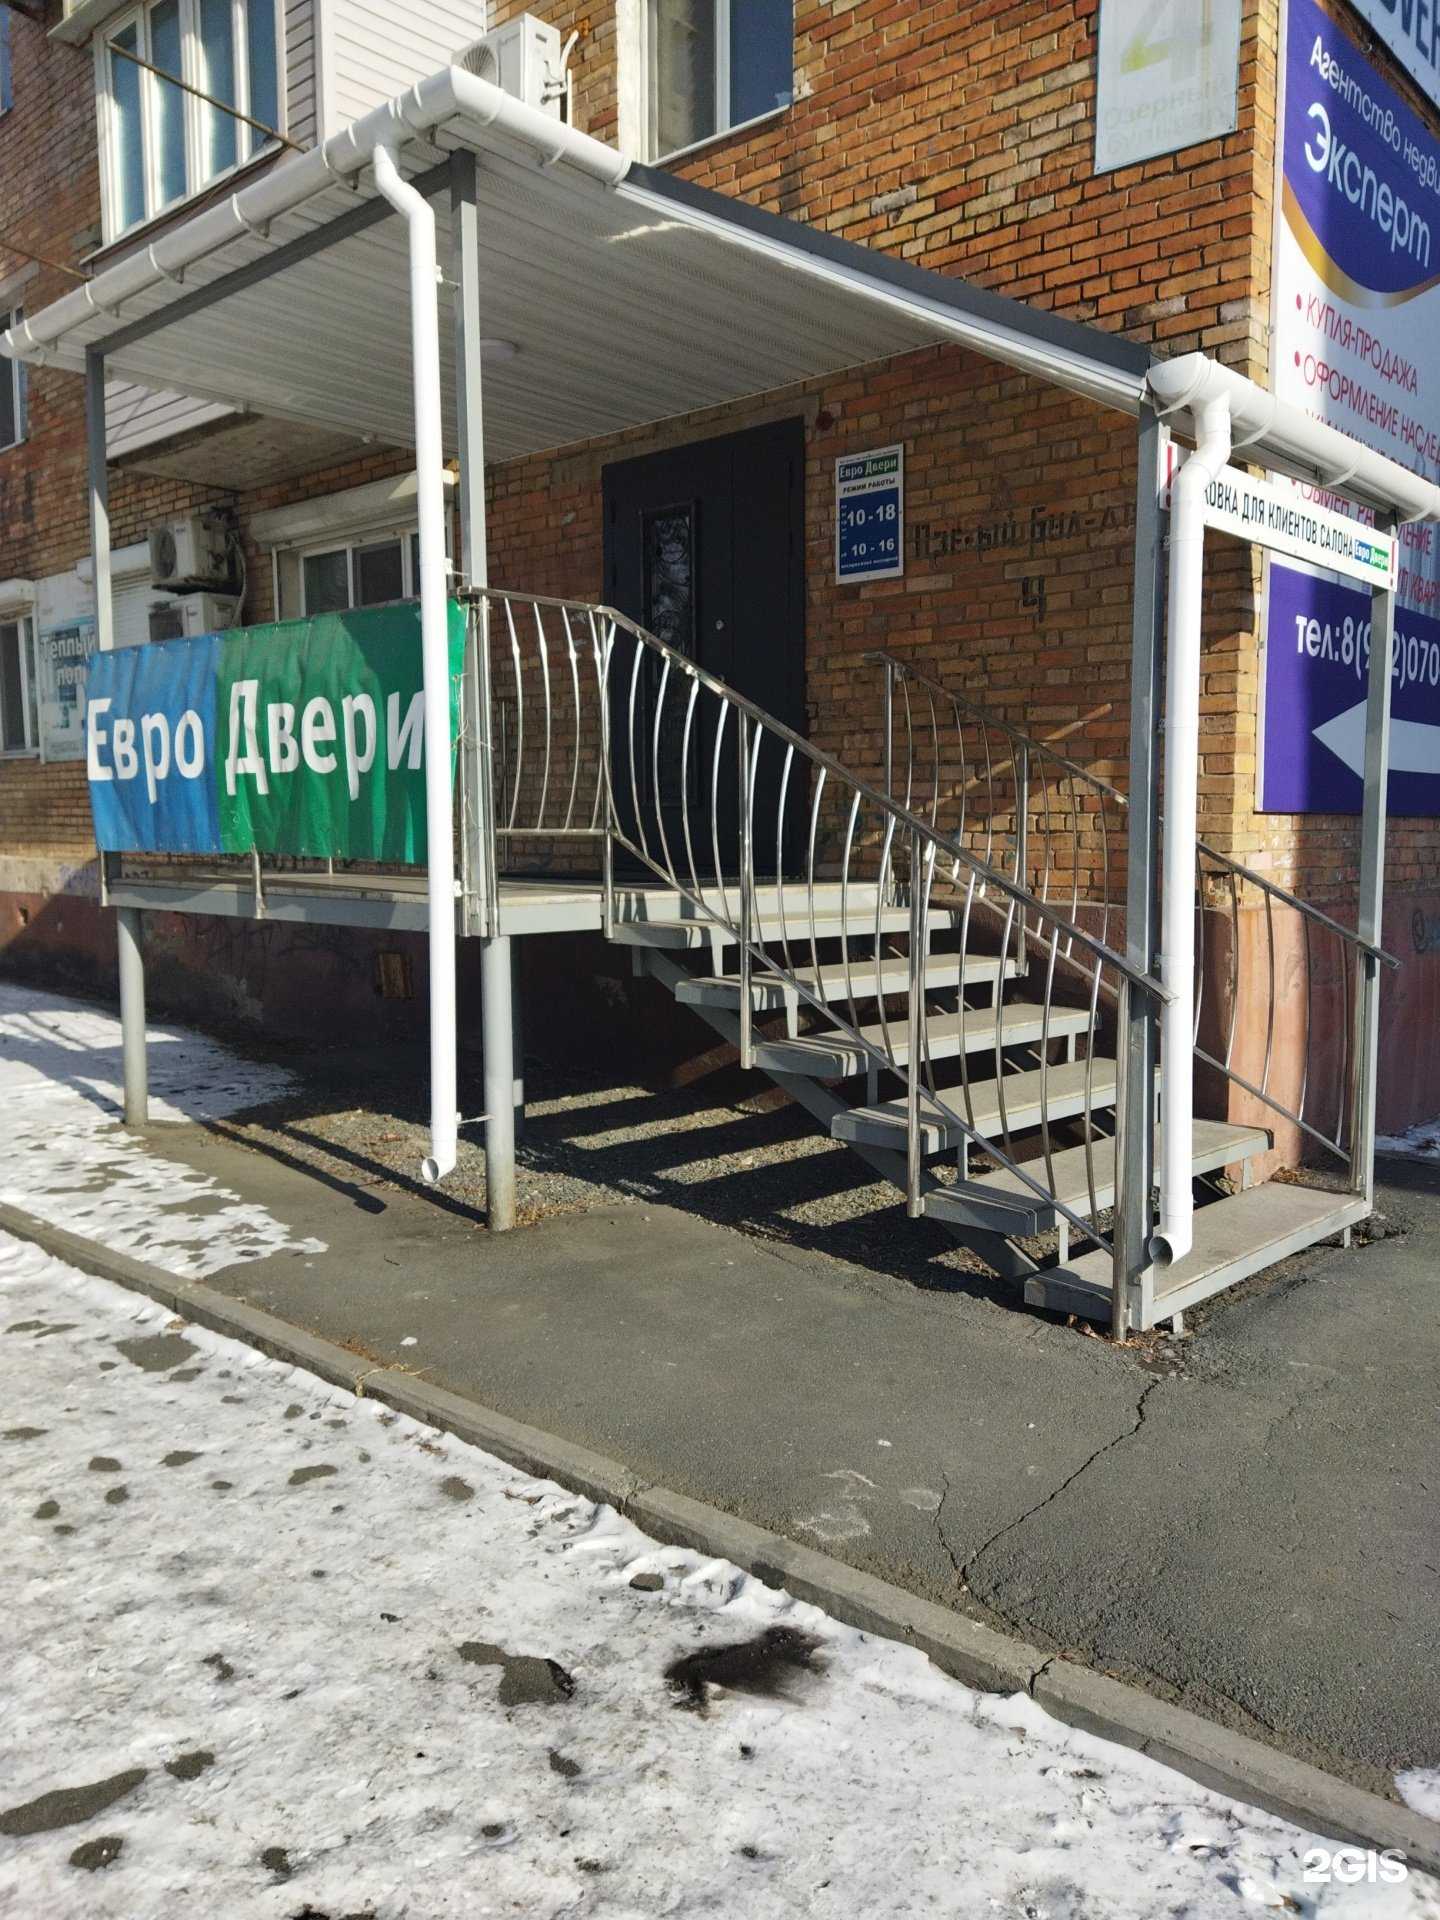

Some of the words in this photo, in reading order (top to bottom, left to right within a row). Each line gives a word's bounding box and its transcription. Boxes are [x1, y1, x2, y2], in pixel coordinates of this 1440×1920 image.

[1310, 35, 1401, 152] Агентство
[1305, 102, 1431, 268] Эксперт
[1303, 354, 1399, 437] ОФОРМЛЕНИЕ
[1306, 293, 1418, 396] КУПЛЯ-ПРОДАЖА
[840, 466, 864, 479] Евро
[865, 458, 896, 476] Двери
[1242, 493, 1265, 525] ДЛЯ
[1269, 501, 1318, 545] КЛИЕНТОВ
[1320, 525, 1354, 559] САЛОНА
[86, 698, 205, 803] Евро
[225, 679, 427, 801] Двери
